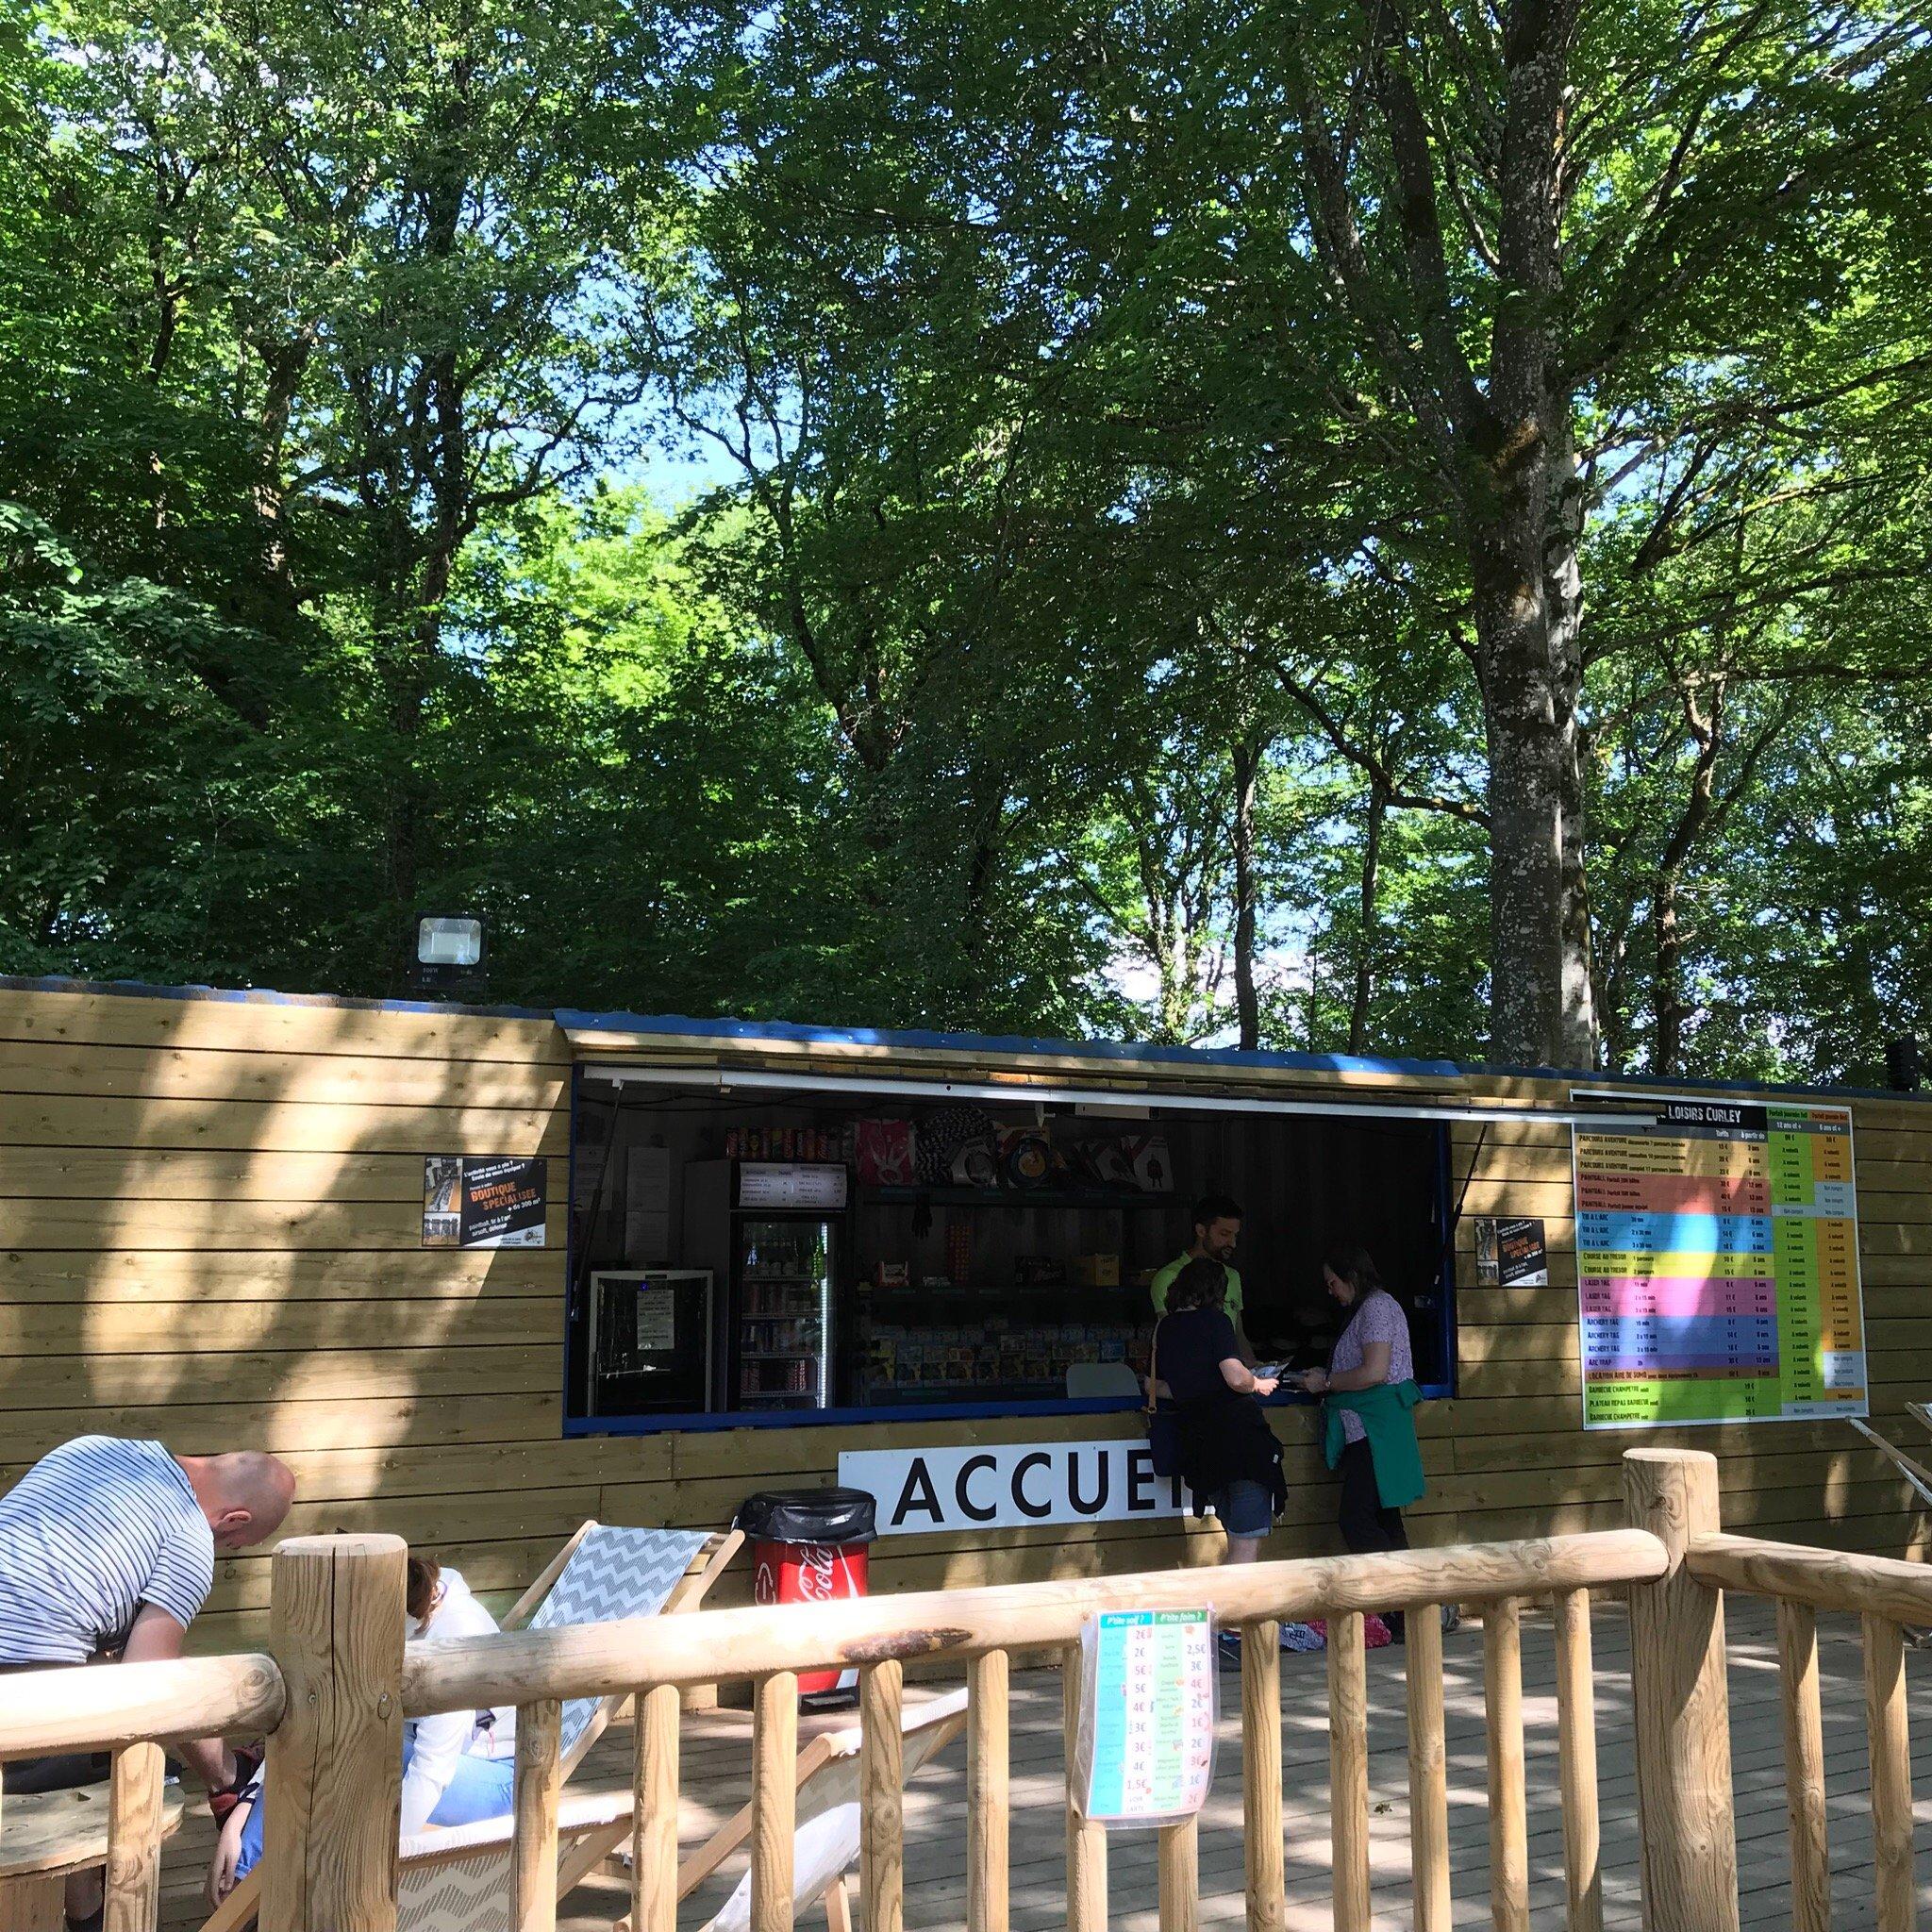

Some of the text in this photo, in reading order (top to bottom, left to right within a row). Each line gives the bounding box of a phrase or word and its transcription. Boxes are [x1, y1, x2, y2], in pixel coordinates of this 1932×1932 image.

[1668, 1106, 1704, 1122] LOISIRS
[1706, 1107, 1741, 1124] CURLEY
[471, 1182, 517, 1202] BOUTIQUE
[890, 1449, 1181, 1525] ACCUEI
[1135, 1630, 1146, 1640] 2€
[1135, 1647, 1145, 1657] 2€
[1135, 1665, 1146, 1675] 5€
[1135, 1683, 1146, 1693] 5€
[1133, 1702, 1144, 1712] 4€
[1133, 1761, 1144, 1771] 4€
